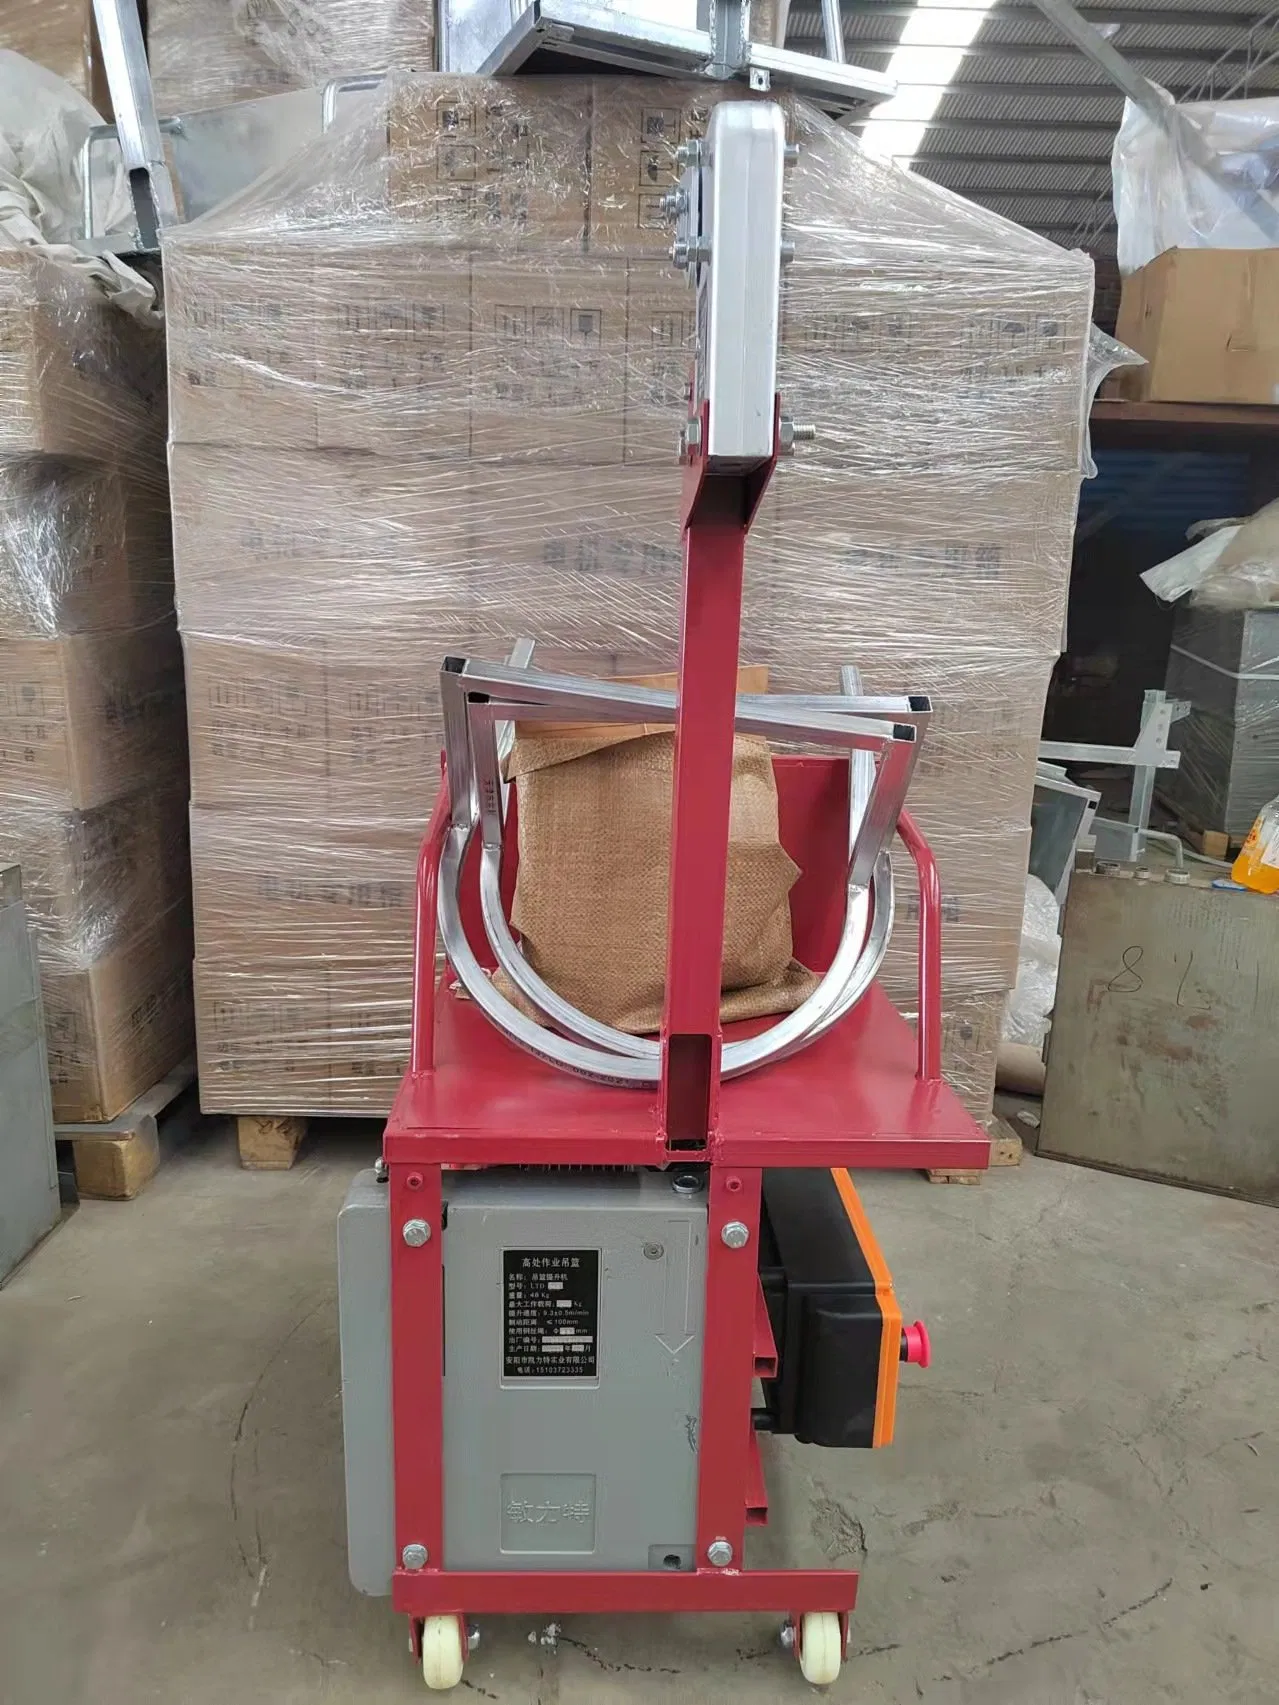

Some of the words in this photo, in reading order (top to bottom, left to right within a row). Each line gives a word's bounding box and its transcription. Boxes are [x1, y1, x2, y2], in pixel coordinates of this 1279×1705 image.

[522, 1257, 580, 1267] 高处作业吊篮
